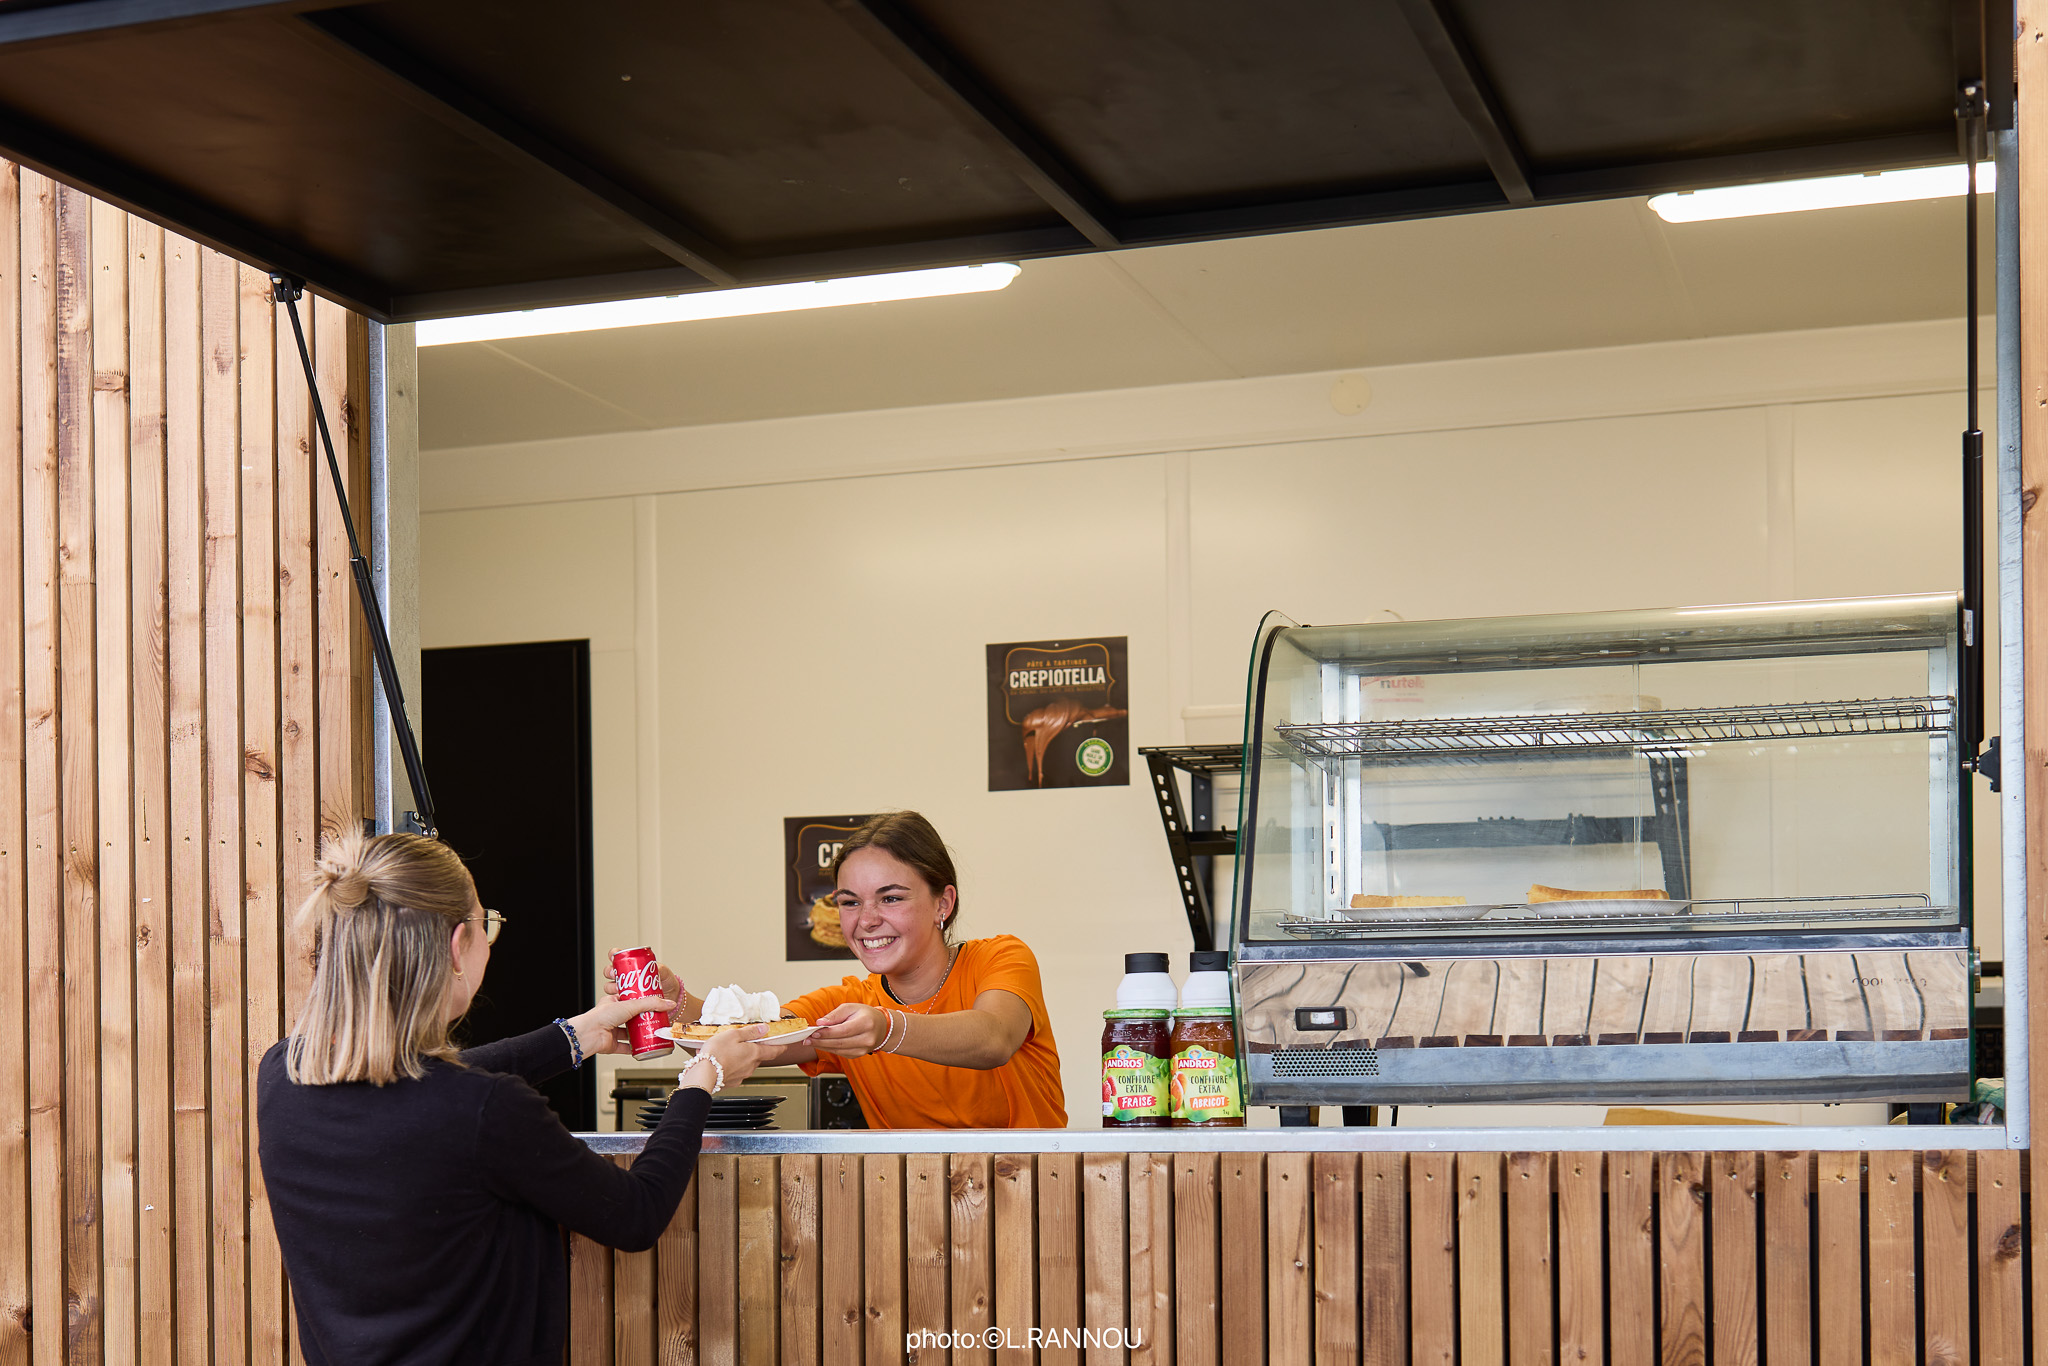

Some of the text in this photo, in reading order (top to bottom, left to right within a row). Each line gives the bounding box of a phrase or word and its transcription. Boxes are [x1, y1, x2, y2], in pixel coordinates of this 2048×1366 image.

[1009, 667, 1106, 688] CREPIOTELLA
[1107, 1059, 1143, 1069] ANDROS
[1178, 1059, 1216, 1069] ANDROS
[1118, 1074, 1156, 1085] CONFITURE
[1190, 1074, 1229, 1085] CONFITURE
[1125, 1084, 1149, 1093] EXTRA
[1198, 1084, 1222, 1094] EXTRA
[1121, 1096, 1153, 1108] FRAISE
[1192, 1096, 1226, 1109] ABRICOT
